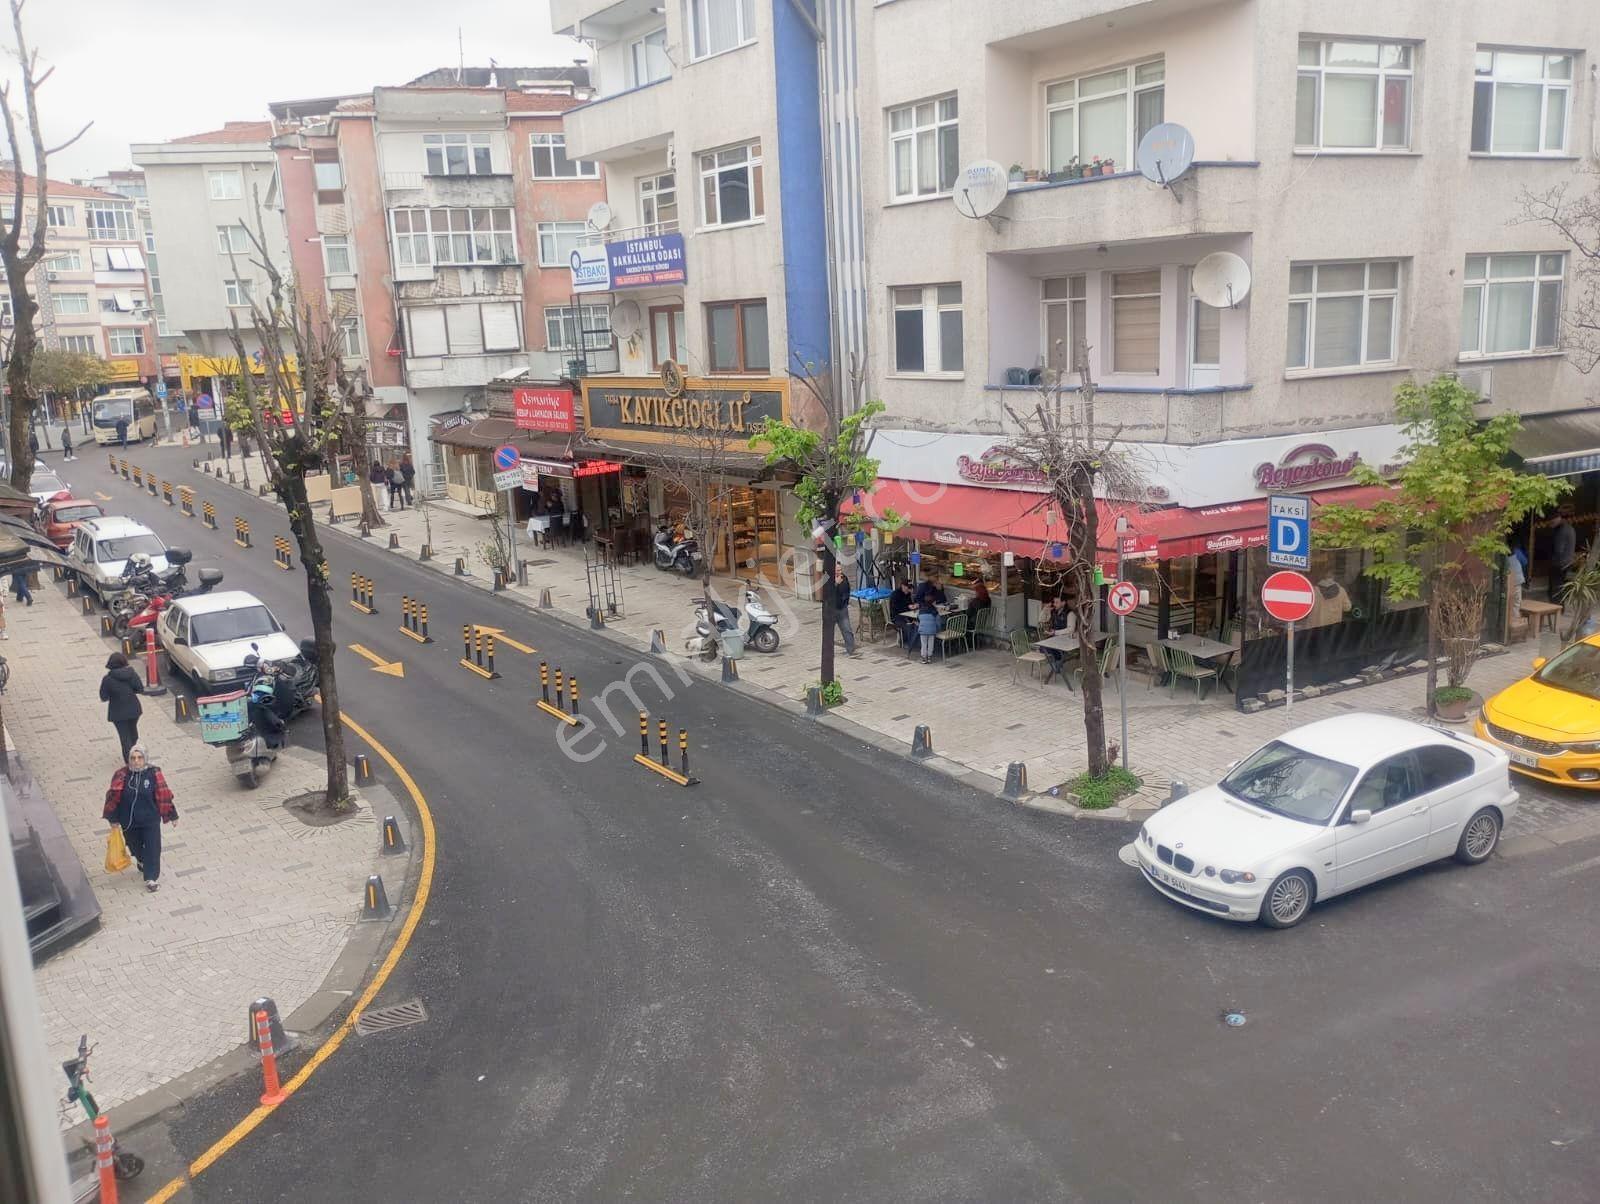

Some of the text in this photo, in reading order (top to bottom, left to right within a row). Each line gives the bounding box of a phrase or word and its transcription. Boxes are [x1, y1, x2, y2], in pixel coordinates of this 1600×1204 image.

[626, 239, 664, 254] İSTANBUL
[612, 248, 682, 267] BAKKALLAR ODASI
[1273, 505, 1305, 516] TAKSİ
[1277, 519, 1300, 552] D
